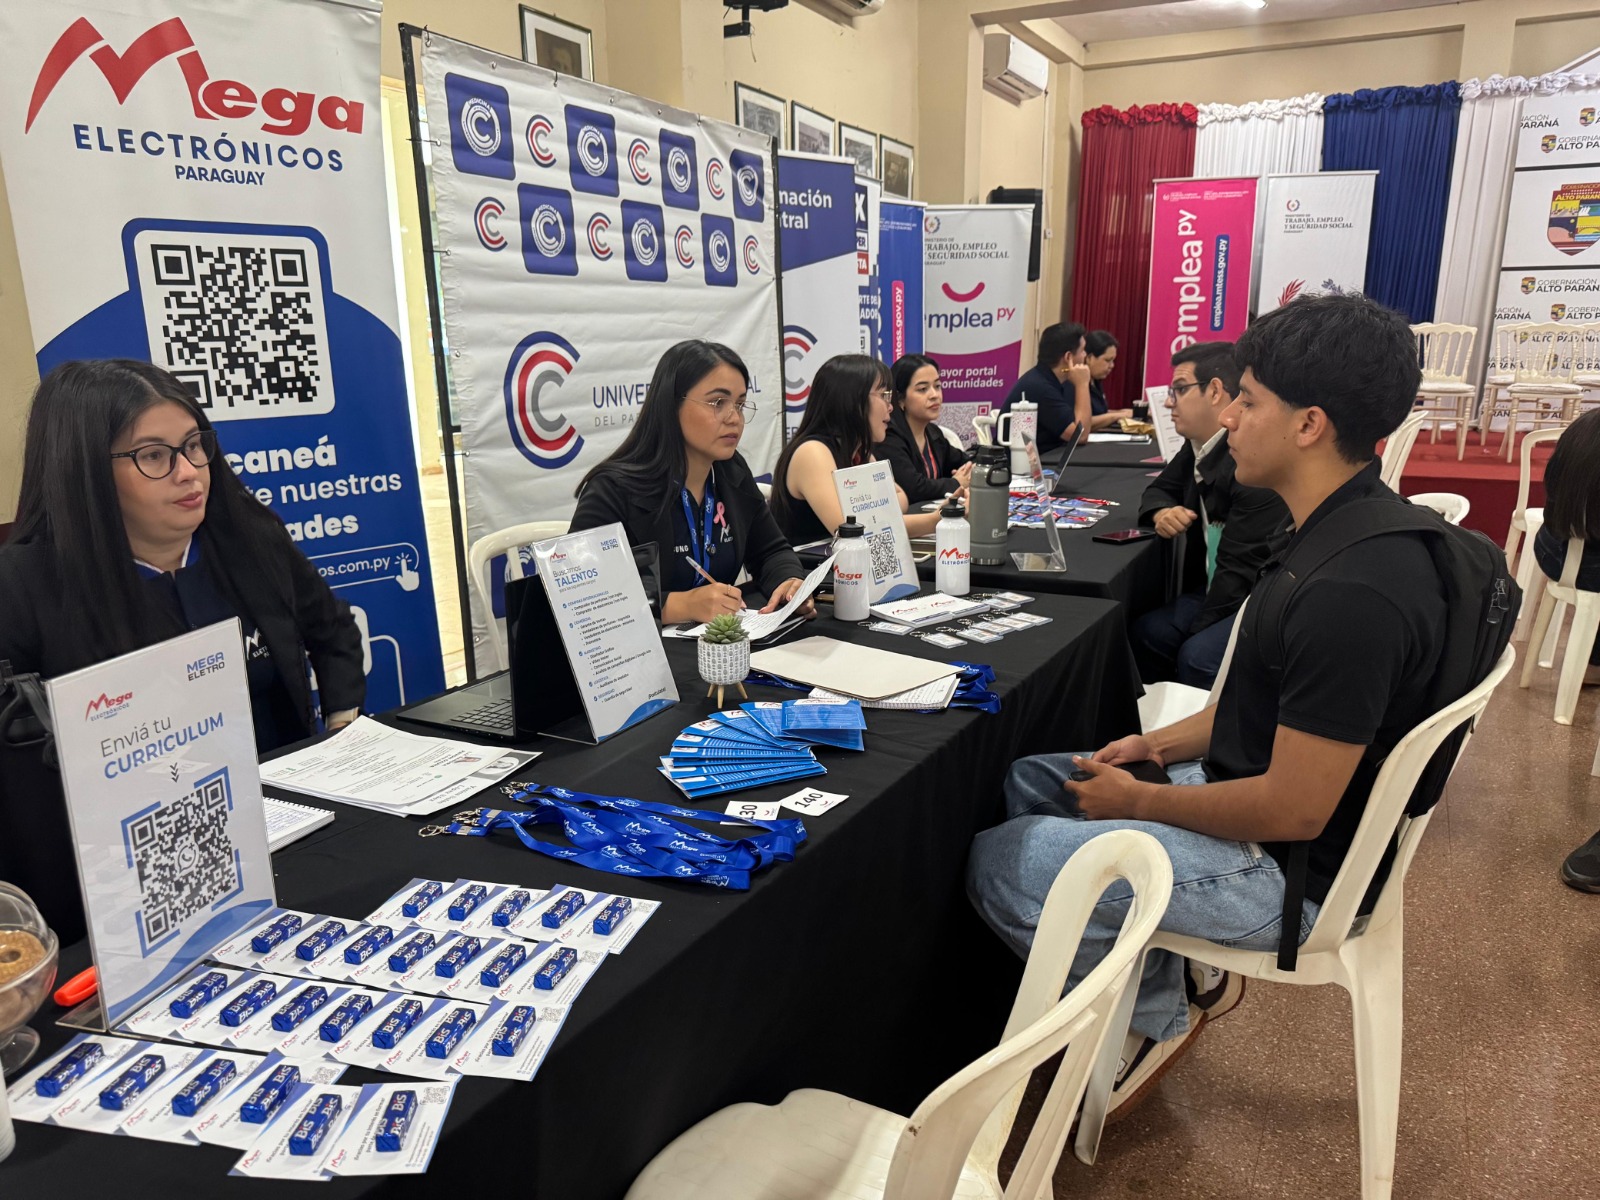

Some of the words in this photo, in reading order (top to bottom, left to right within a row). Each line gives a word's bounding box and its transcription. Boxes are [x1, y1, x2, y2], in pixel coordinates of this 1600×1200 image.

[26, 16, 365, 136] Mega
[73, 124, 343, 172] ELECTRÓNICOS
[1586, 141, 1600, 149] PA
[175, 165, 265, 186] PARAGUAY
[780, 211, 809, 230] tral
[1177, 209, 1197, 236] py
[927, 251, 977, 260] SEGURIDAD
[962, 242, 997, 250] EMPLEO
[1564, 284, 1600, 292] PARAN
[926, 307, 993, 332] mplea
[996, 306, 1015, 321] py
[941, 368, 962, 379] ayor
[966, 365, 997, 378] portal
[941, 378, 1004, 389] ortunidades
[594, 416, 616, 428] DEL
[224, 435, 337, 475] caneá
[280, 473, 402, 503] nuestras
[852, 498, 889, 513] CURRICULUM
[286, 513, 359, 542] ades
[938, 547, 970, 560] Meg
[318, 556, 391, 577] os.com.py
[555, 568, 598, 587] TALENTOS
[187, 652, 224, 673] MEGA
[188, 662, 225, 681] ELETRO
[85, 692, 133, 721] Mega
[100, 722, 149, 758] Enviá
[153, 716, 171, 734] tu
[104, 712, 224, 779] CURRICULUM
[795, 792, 823, 808] 140
[740, 804, 758, 820] 30
